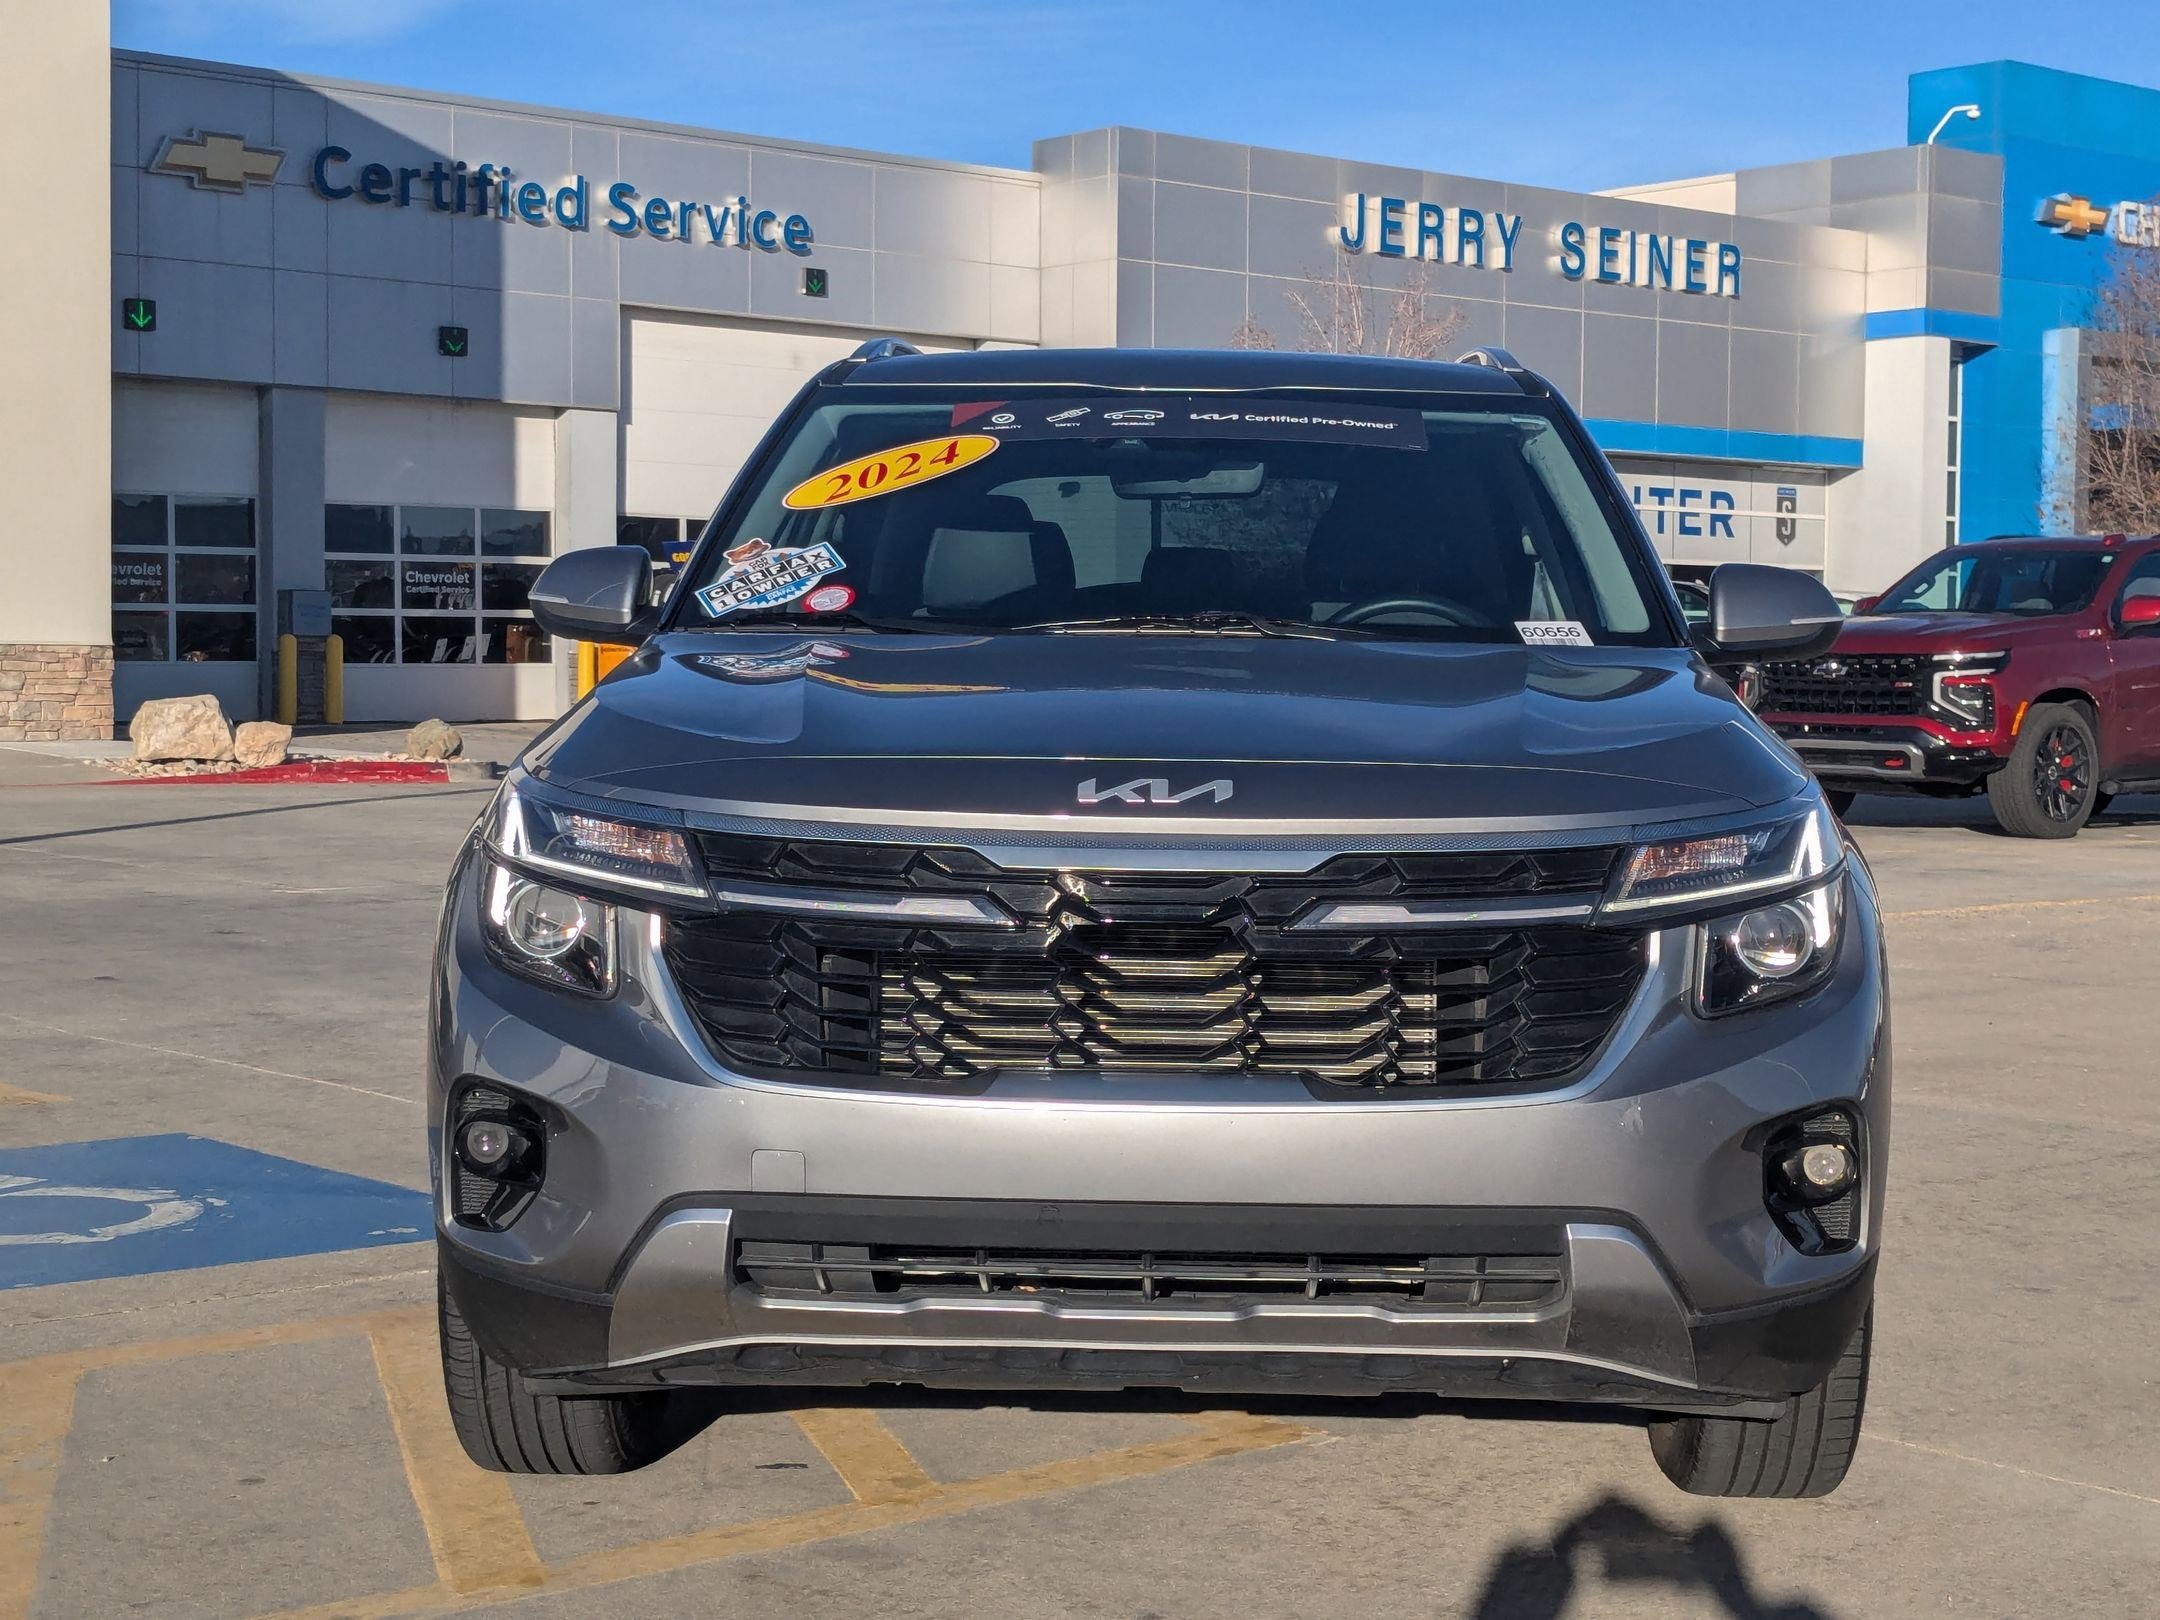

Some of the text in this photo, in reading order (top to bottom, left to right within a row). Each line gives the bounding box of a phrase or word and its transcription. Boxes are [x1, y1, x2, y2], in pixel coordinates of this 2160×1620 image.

[313, 145, 814, 254] Certified Service
[1339, 193, 1742, 298] JERRY SEINER
[1245, 415, 1308, 424] Certified
[824, 440, 960, 504] 2024
[405, 571, 470, 583] Chevrolet
[406, 585, 440, 593] Certified
[709, 551, 827, 599] CARFAX
[736, 560, 834, 601] OWNER
[1520, 626, 1581, 638] 60656
